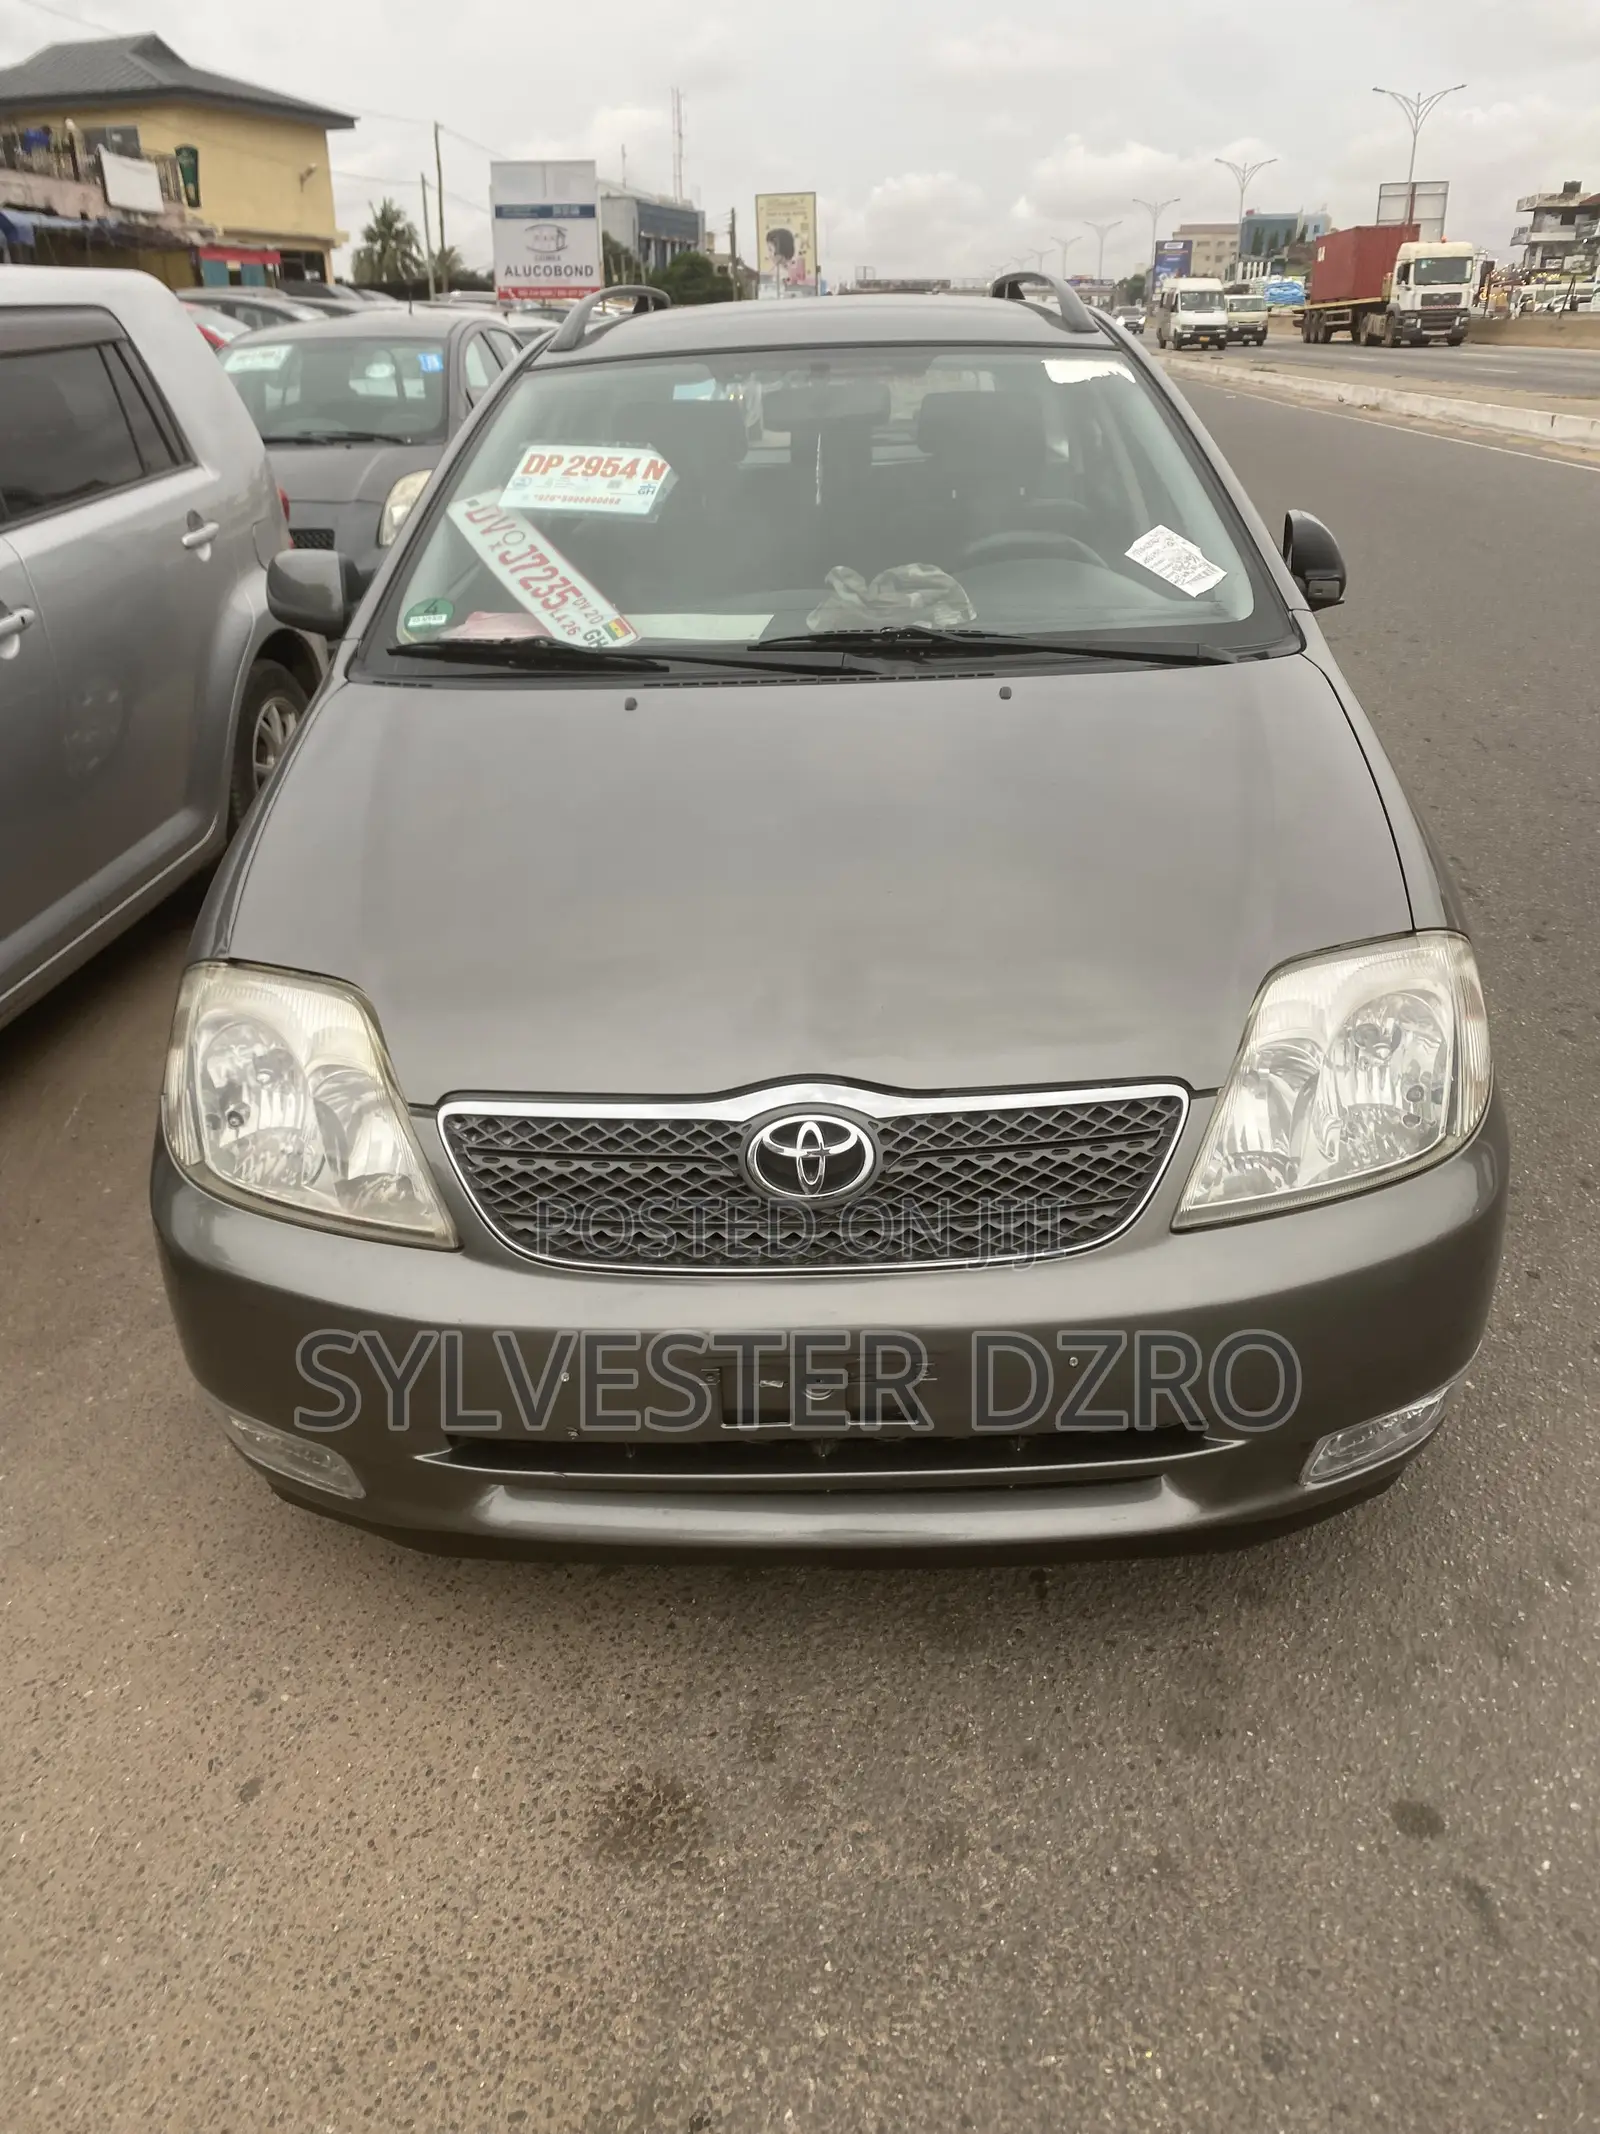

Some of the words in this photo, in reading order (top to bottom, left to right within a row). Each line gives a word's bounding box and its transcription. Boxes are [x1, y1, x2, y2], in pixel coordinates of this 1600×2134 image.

[504, 265, 594, 277] ALUCOBOND
[521, 453, 565, 476] DP
[561, 454, 642, 480] 2954
[641, 458, 670, 482] N
[497, 543, 584, 612] J7235
[423, 599, 438, 614] 4
